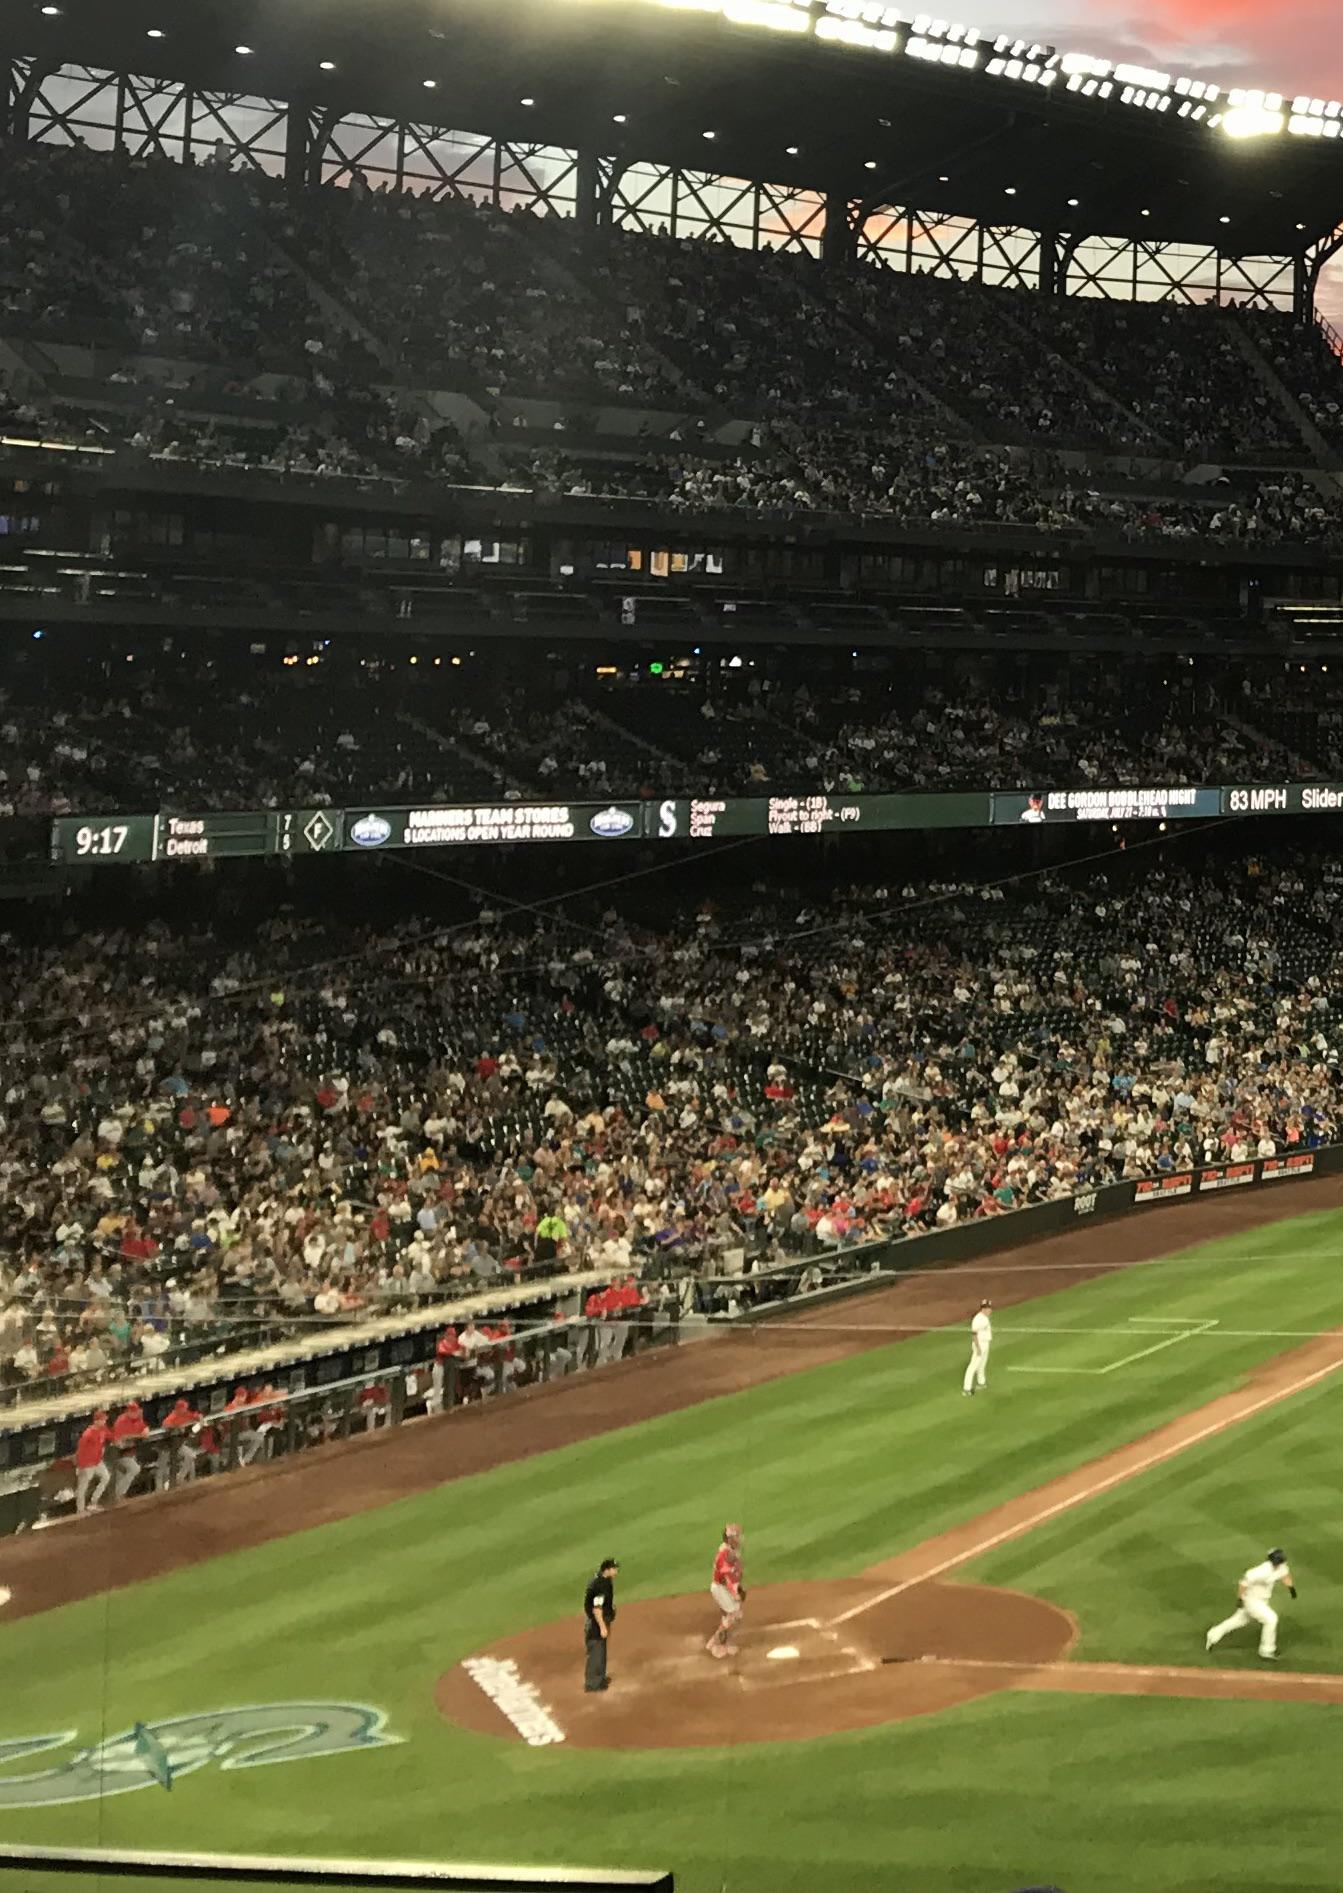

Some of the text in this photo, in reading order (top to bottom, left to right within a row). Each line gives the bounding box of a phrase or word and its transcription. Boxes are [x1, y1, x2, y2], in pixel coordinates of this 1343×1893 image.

[690, 799, 726, 815] Segura
[769, 797, 798, 812] Single
[1048, 793, 1067, 810] DEE
[1068, 791, 1107, 808] GORDON
[1168, 788, 1197, 805] NIGHT
[1230, 789, 1287, 811] 83 MPH
[169, 815, 291, 834] Texas 7
[475, 808, 513, 826] TEAM
[514, 806, 569, 825] STORES
[691, 812, 716, 826] Span
[769, 809, 798, 824] Flyout
[799, 809, 810, 821] to
[810, 807, 834, 823] right
[412, 826, 466, 843] LOCATIONS
[467, 824, 500, 840] OPEN
[500, 824, 531, 839] YEAR
[532, 822, 575, 838] ROUND
[769, 822, 792, 834] Walk
[76, 826, 128, 854] 9:17
[167, 834, 290, 855] Detroit 5
